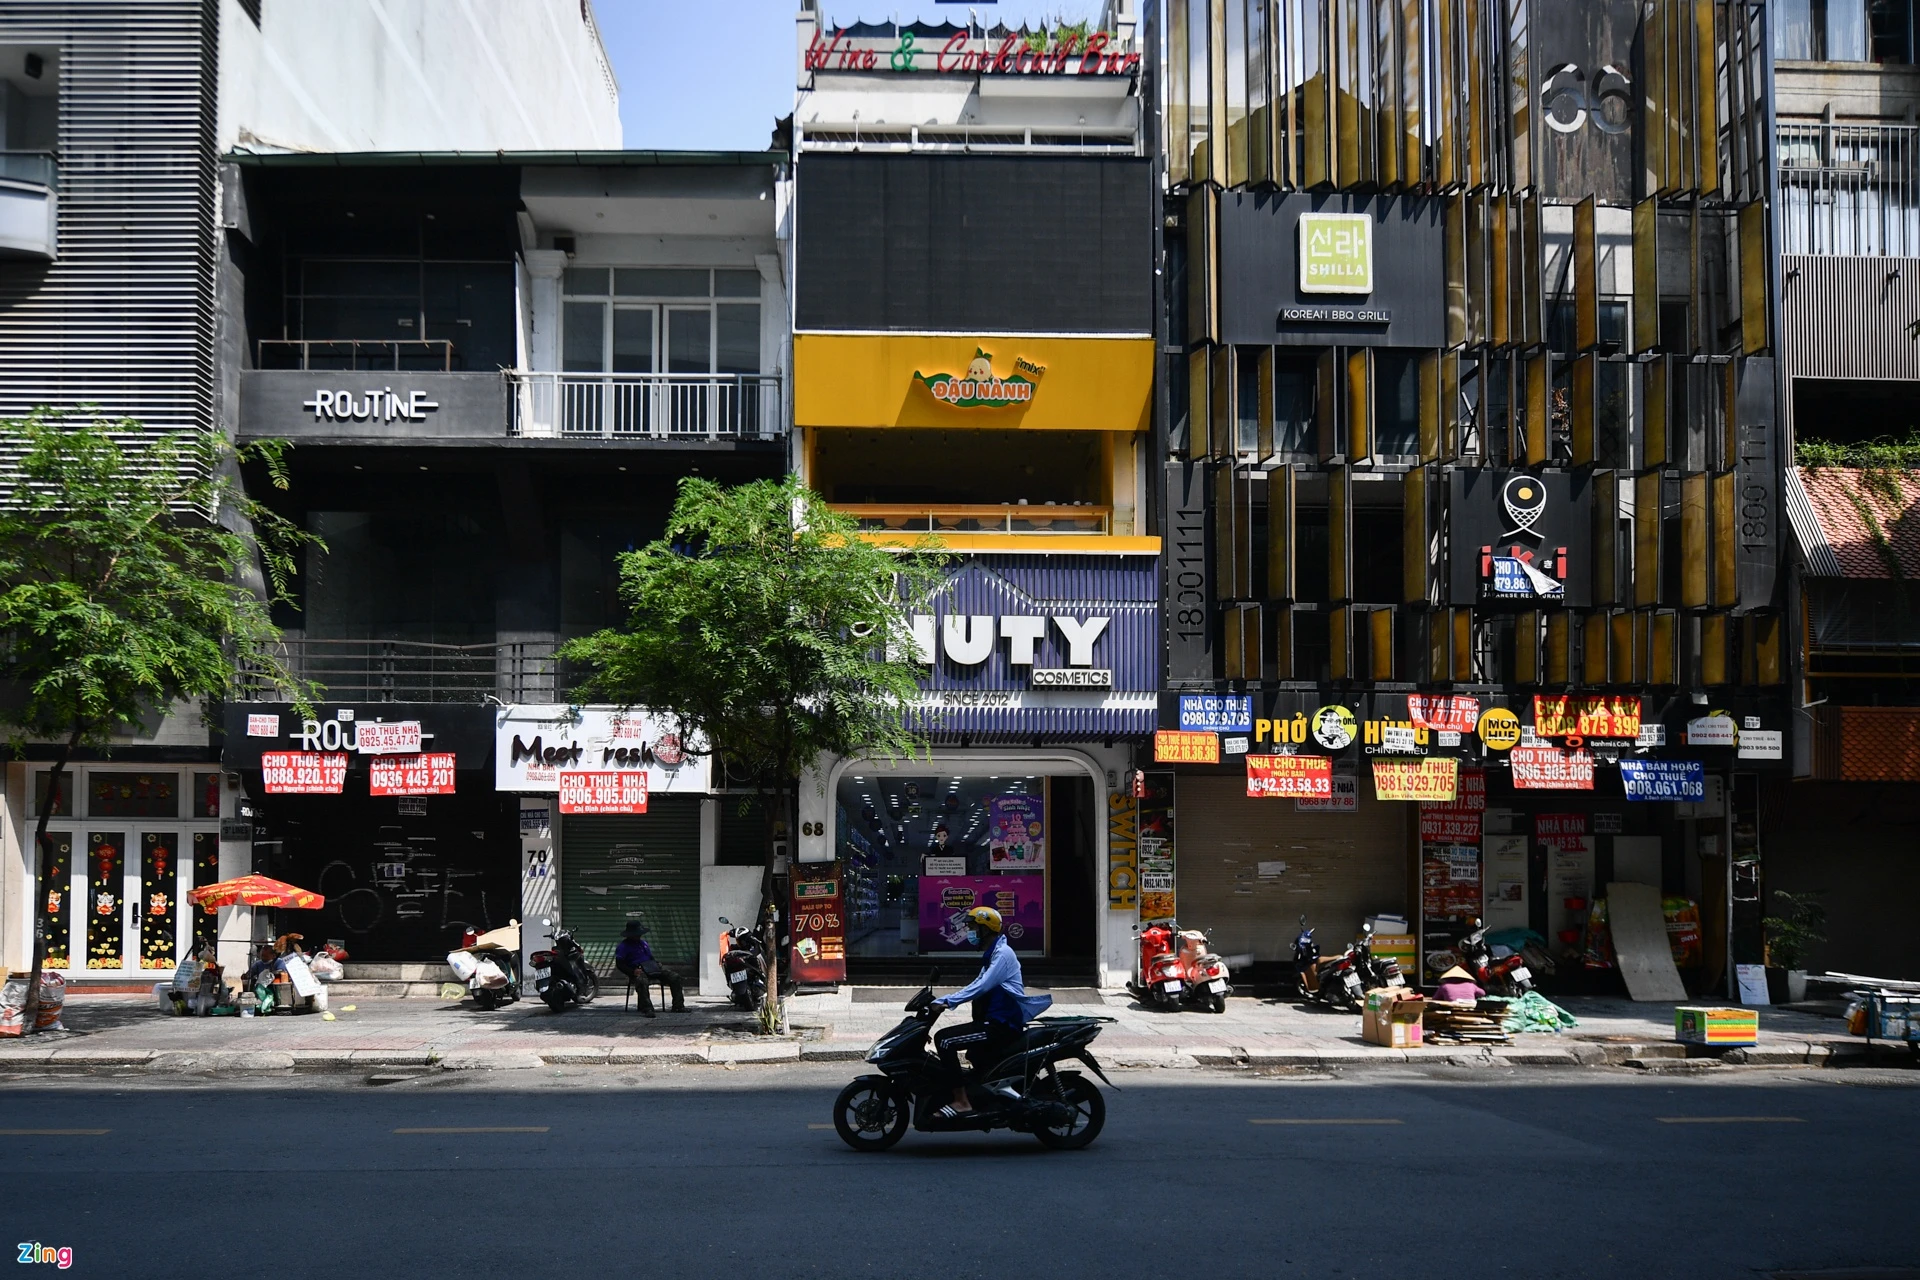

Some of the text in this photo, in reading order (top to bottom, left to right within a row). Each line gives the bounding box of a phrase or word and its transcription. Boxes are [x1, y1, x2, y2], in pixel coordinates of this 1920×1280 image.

[804, 28, 1141, 74] Wine & Cocktail Bar
[1541, 63, 1631, 134] 66
[1309, 263, 1364, 276] SHILLA
[1284, 309, 1389, 321] KOREAN BBQ GRILL
[933, 378, 975, 403] ĐẬU
[1176, 509, 1205, 642] 18001111
[885, 615, 1111, 665] NUTY
[1033, 671, 1109, 684] COSMETICS
[943, 693, 1009, 707] SINCE 2012
[1184, 697, 1248, 711] NHÀ CHO THUÊ
[1409, 697, 1429, 707] CHO
[1432, 697, 1456, 709] THUÊ
[1536, 697, 1639, 716] CHO THUÊ NHÀ
[1182, 711, 1250, 726] 0981.929.705
[1411, 707, 1433, 720] 0911
[1437, 710, 1462, 722] 7777
[360, 724, 419, 736] CHO THUÊ NHÀ
[1255, 712, 1307, 743] PHỞ
[1536, 716, 1639, 736] 0908 875 399
[360, 735, 419, 747] 0925.45.47.47
[512, 734, 583, 765] Meet
[1157, 745, 1216, 761] 0922.16.36.36
[1510, 749, 1534, 763] CHO
[1537, 748, 1566, 763] THUÊ
[1569, 748, 1592, 764] NHÀ
[263, 752, 347, 767] CHO THUÊ NHÀ
[372, 753, 454, 770] CHO THUÊ NHÀ
[1248, 755, 1271, 769] NHÀ
[1273, 757, 1297, 769] CHO
[1299, 756, 1328, 770] THUÊ
[1373, 757, 1455, 774] NHÀ CHO THUÊ
[1620, 760, 1700, 773] NHÀ BÁN HOẶC
[263, 768, 347, 784] 0888.920.130
[372, 769, 454, 787] 0936 445 201
[561, 772, 647, 787] CHO THUÊ NHÀ
[1466, 774, 1486, 792] NHÀ
[1633, 770, 1687, 781] CHO THUÊ
[1248, 778, 1330, 792] 0942.33.58.33
[1337, 781, 1355, 793] NHÀ
[561, 788, 647, 805] 0906.905.006
[1321, 798, 1329, 806] 97
[1331, 798, 1341, 806] 97
[1343, 798, 1354, 806] 86
[600, 805, 618, 813] (chính
[255, 826, 267, 835] 72
[802, 821, 824, 837] 68
[1421, 821, 1479, 836] 0931.339.227
[1537, 815, 1585, 834] NHÀ BÁN
[527, 849, 547, 863] 70
[1109, 793, 1137, 911] SWITCH
[795, 913, 840, 932] 70%
